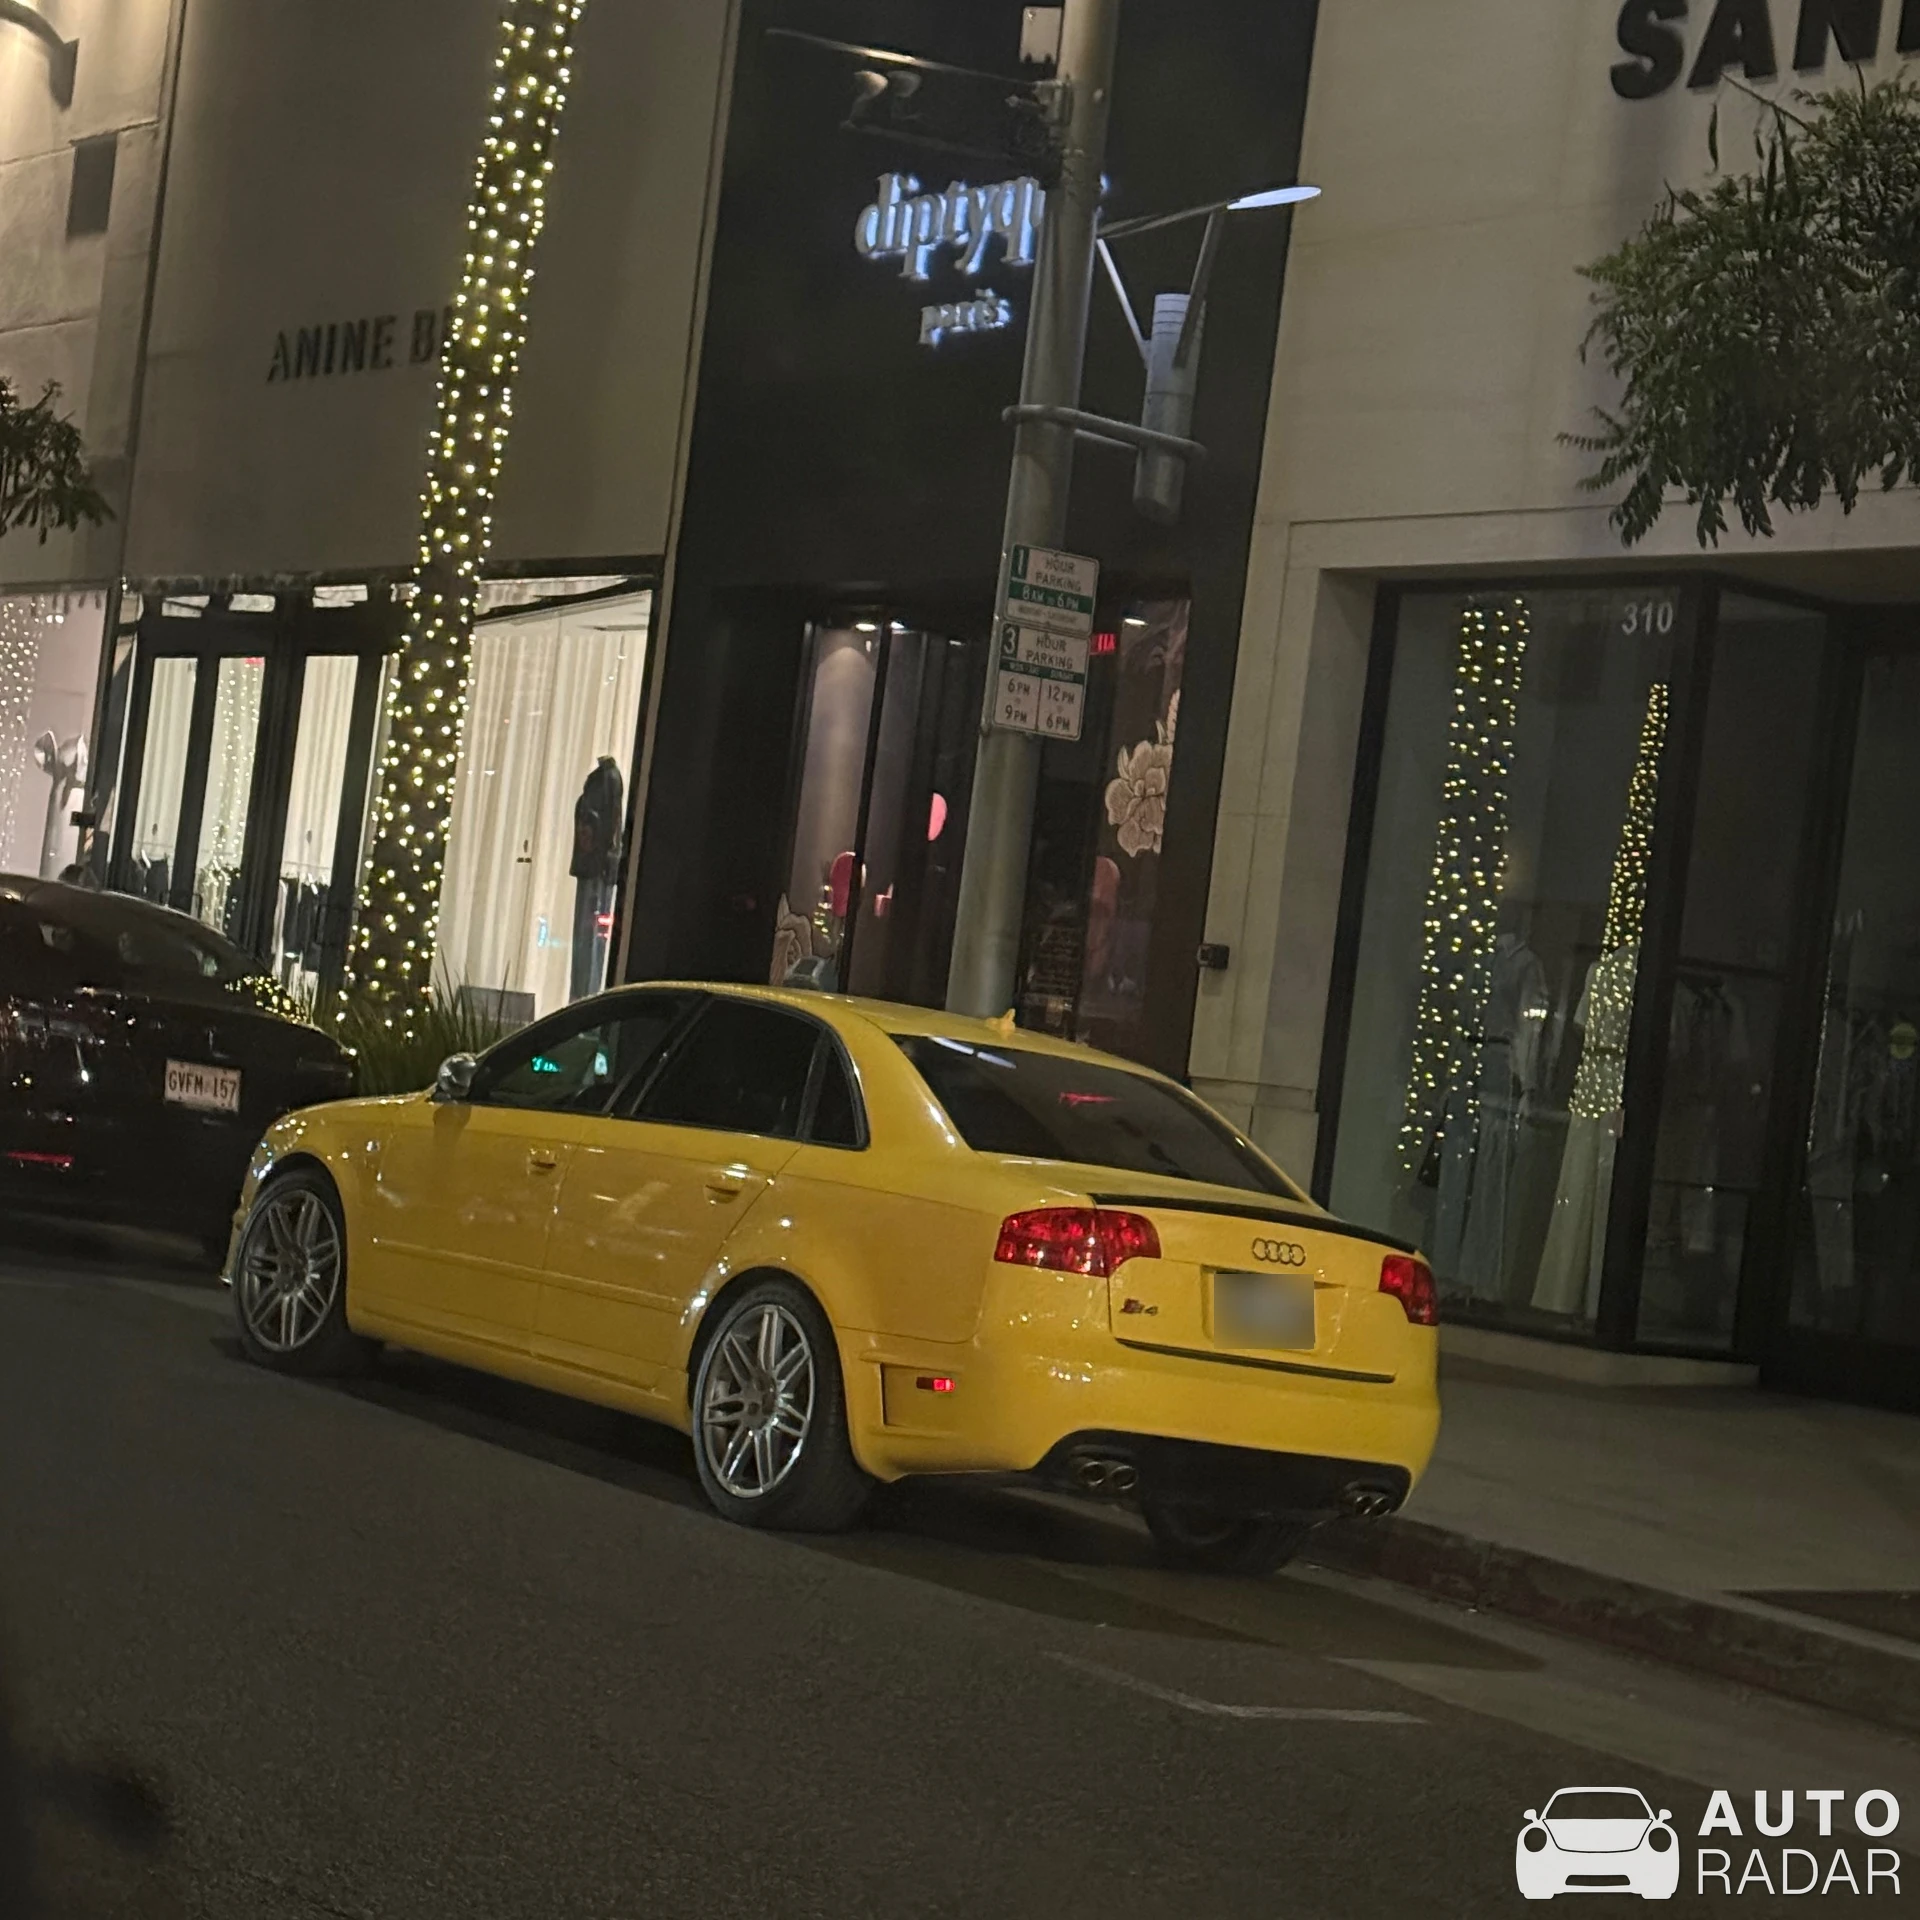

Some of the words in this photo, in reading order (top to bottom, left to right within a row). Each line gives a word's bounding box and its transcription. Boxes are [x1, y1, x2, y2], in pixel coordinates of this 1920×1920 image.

[266, 314, 397, 382] ANINE
[1017, 548, 1025, 575] 1
[1044, 557, 1076, 574] HOUR
[1035, 571, 1082, 592] PARKING
[1622, 601, 1674, 634] 310
[1003, 626, 1017, 655] 3
[1036, 635, 1068, 653] HOUR
[1025, 649, 1074, 670] PARKING
[213, 1076, 237, 1108] 157
